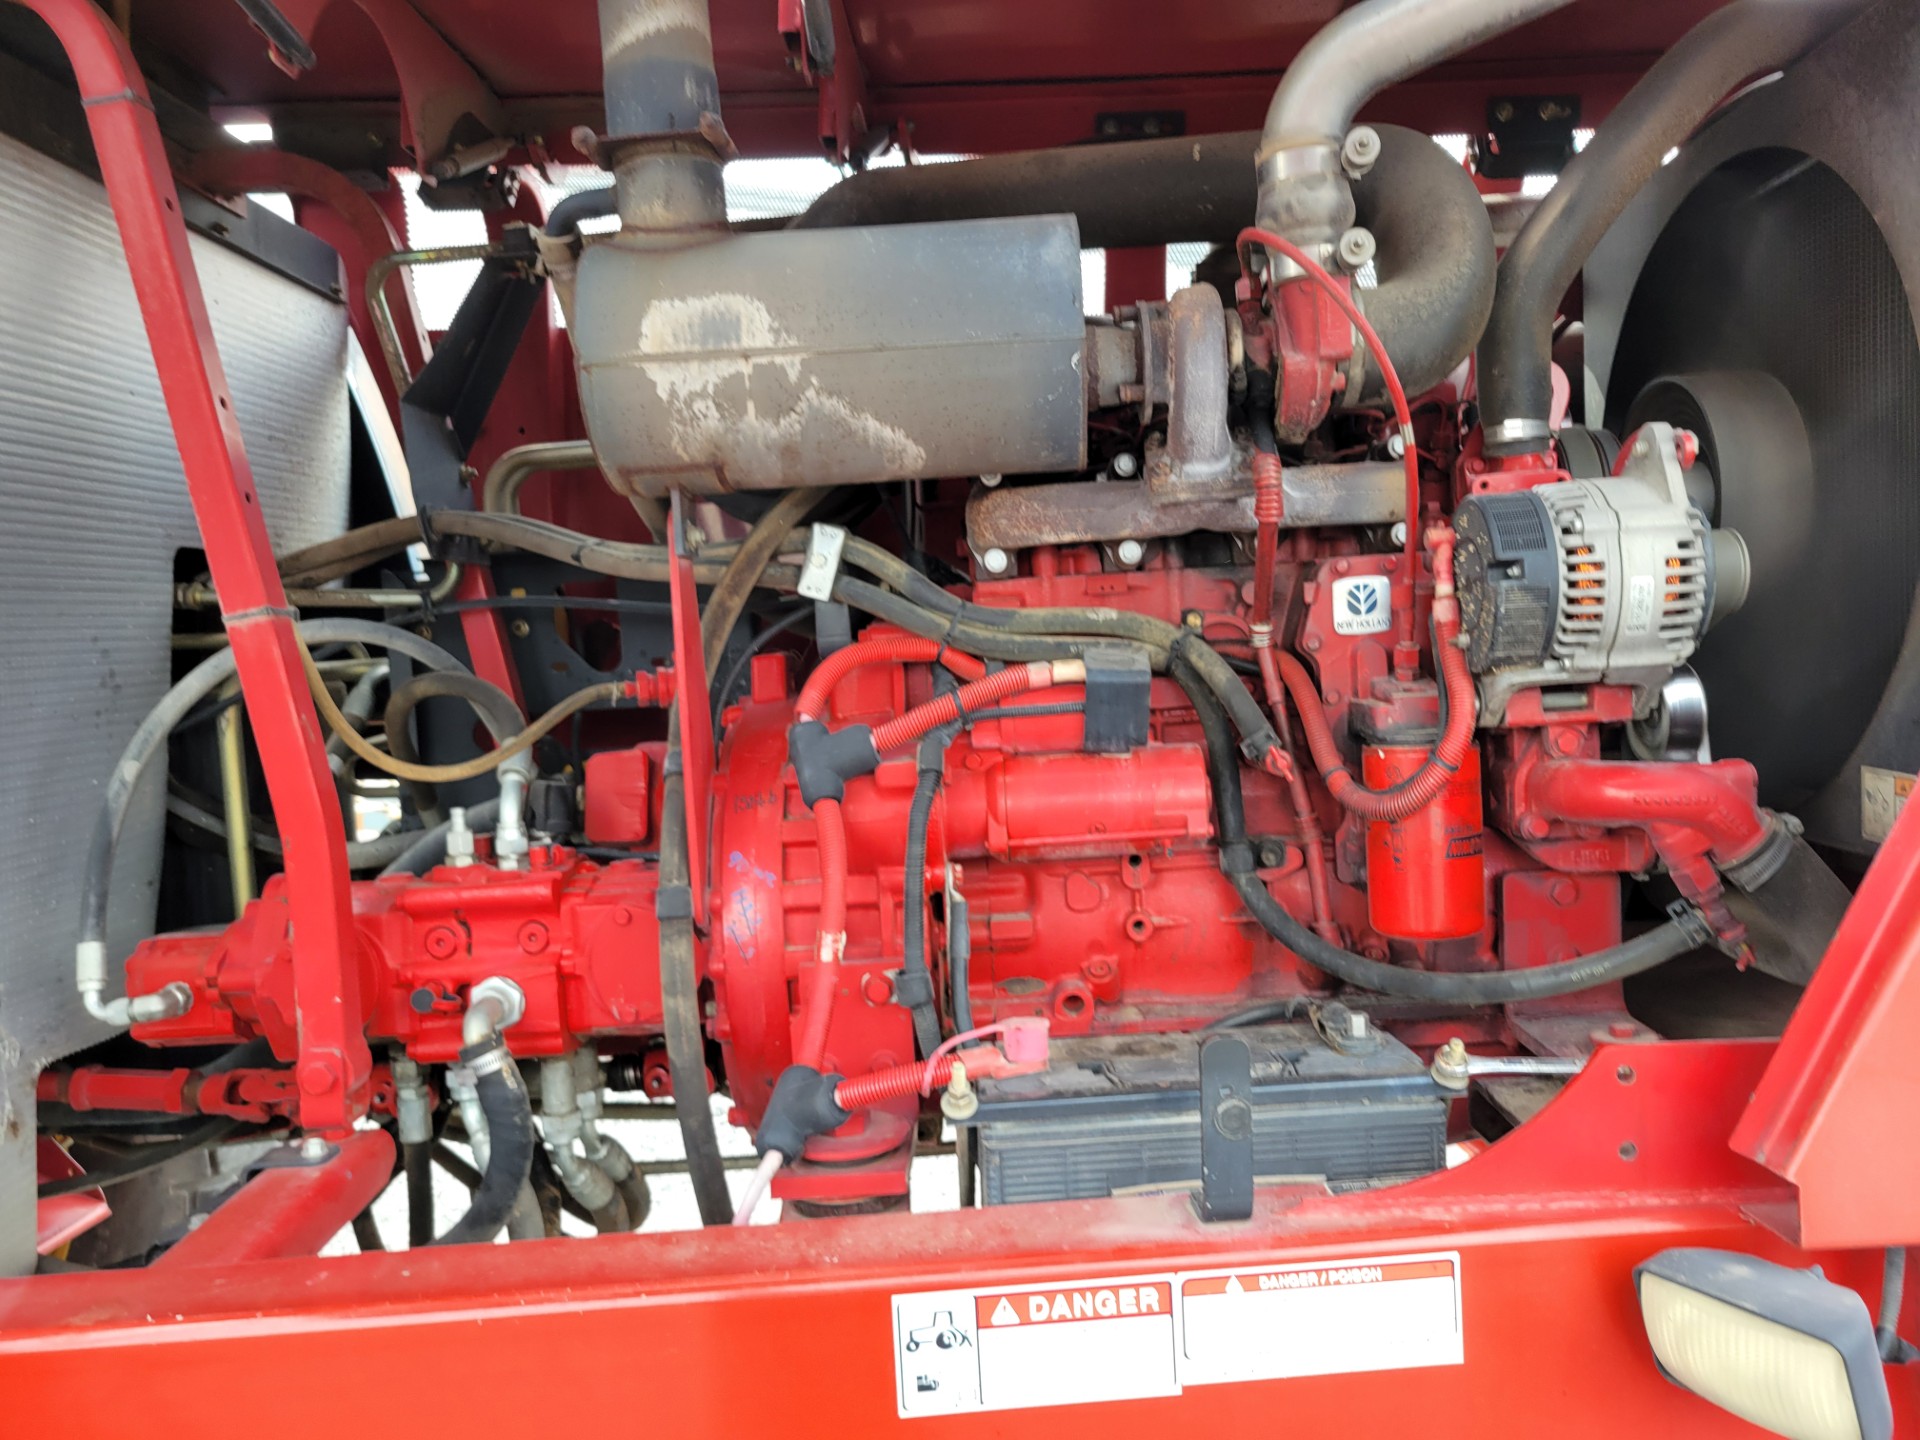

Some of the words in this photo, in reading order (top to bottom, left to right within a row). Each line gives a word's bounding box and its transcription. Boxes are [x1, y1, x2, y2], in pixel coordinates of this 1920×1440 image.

[1258, 1271, 1319, 1290] DANGER
[1328, 1266, 1383, 1285] POISON
[1028, 1285, 1160, 1323] DANGER
